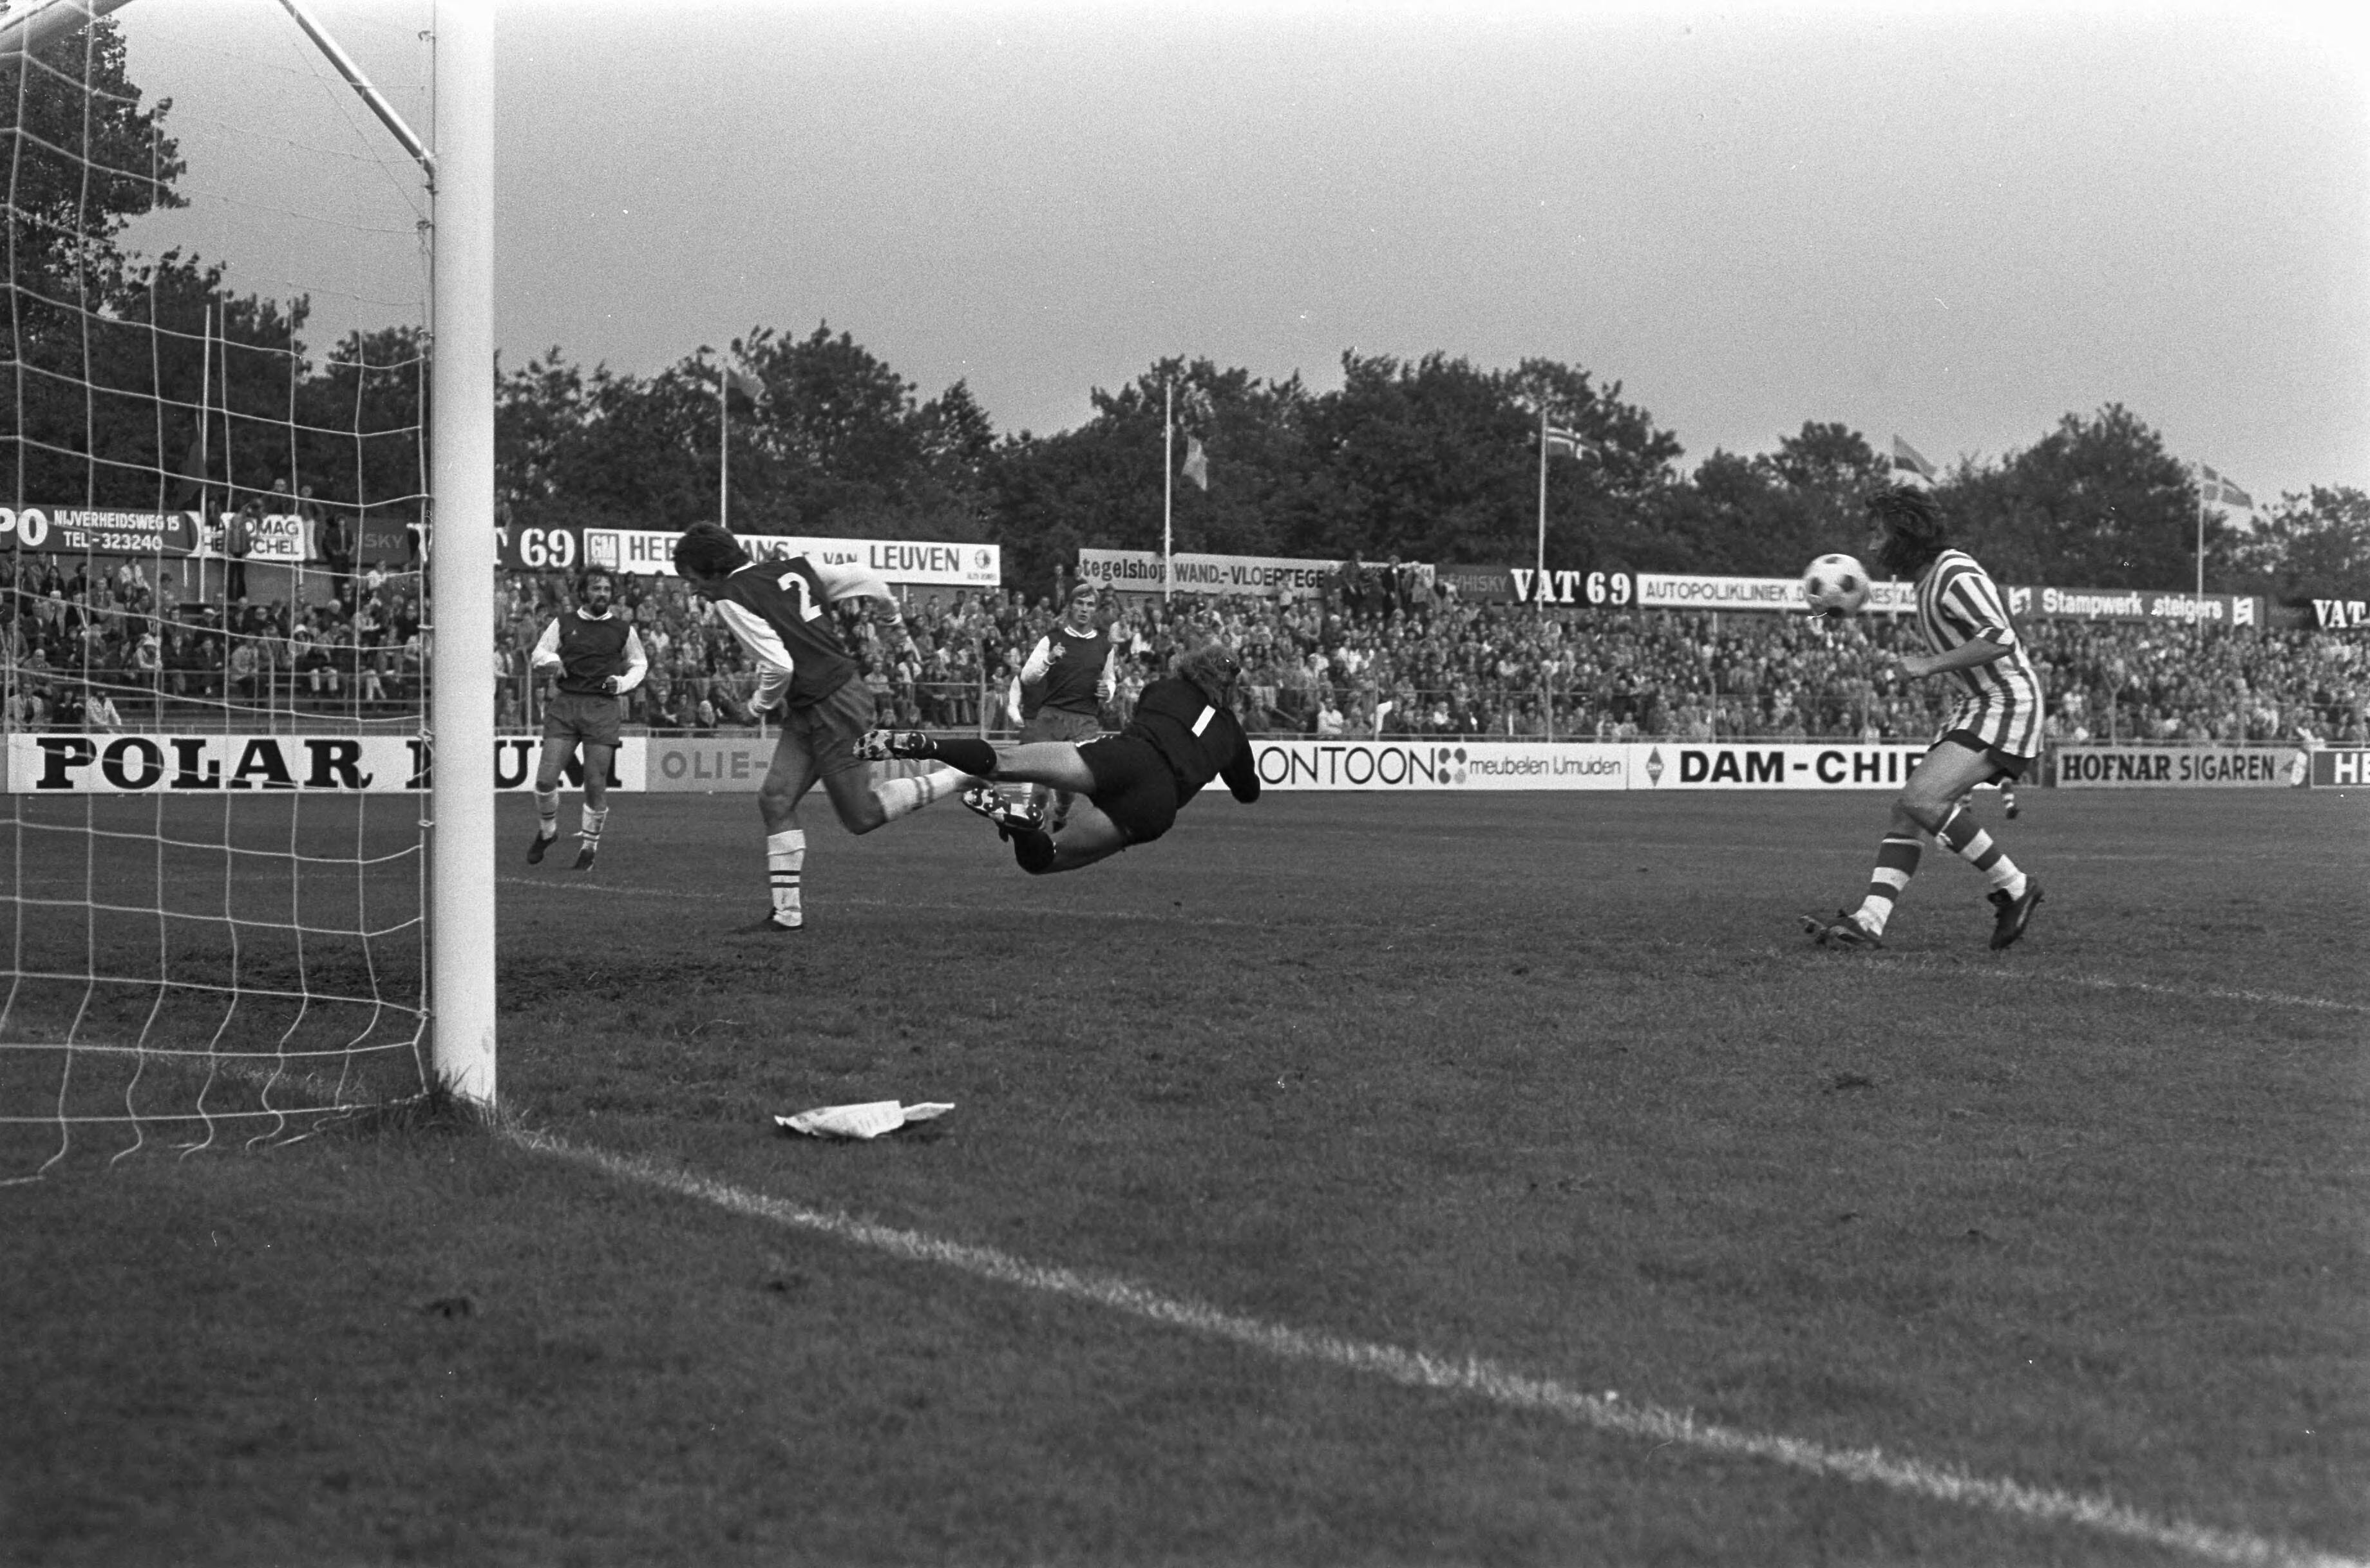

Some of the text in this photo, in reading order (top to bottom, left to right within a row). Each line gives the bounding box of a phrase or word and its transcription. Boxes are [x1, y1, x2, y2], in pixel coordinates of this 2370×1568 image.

[54, 509, 180, 531] NIJVERHEIDSWEG 15
[204, 538, 299, 554] HECHEL
[520, 528, 575, 568] 69
[629, 535, 960, 572] HEEANS VAN LEUVEN
[1083, 558, 1166, 583] tegelshop
[1510, 568, 1580, 603] VAT
[1586, 571, 1631, 605] 69
[777, 572, 822, 623] 2
[2043, 587, 2143, 620] Stampwerk
[2153, 594, 2223, 624] steigers
[2312, 599, 2366, 628] VAT
[1191, 704, 1216, 737] 1
[37, 737, 373, 790] POLAR
[1258, 746, 1435, 785] ONTOON
[1470, 755, 1549, 775] meubelen
[2063, 753, 2275, 781] HOFNAR SIGAREN
